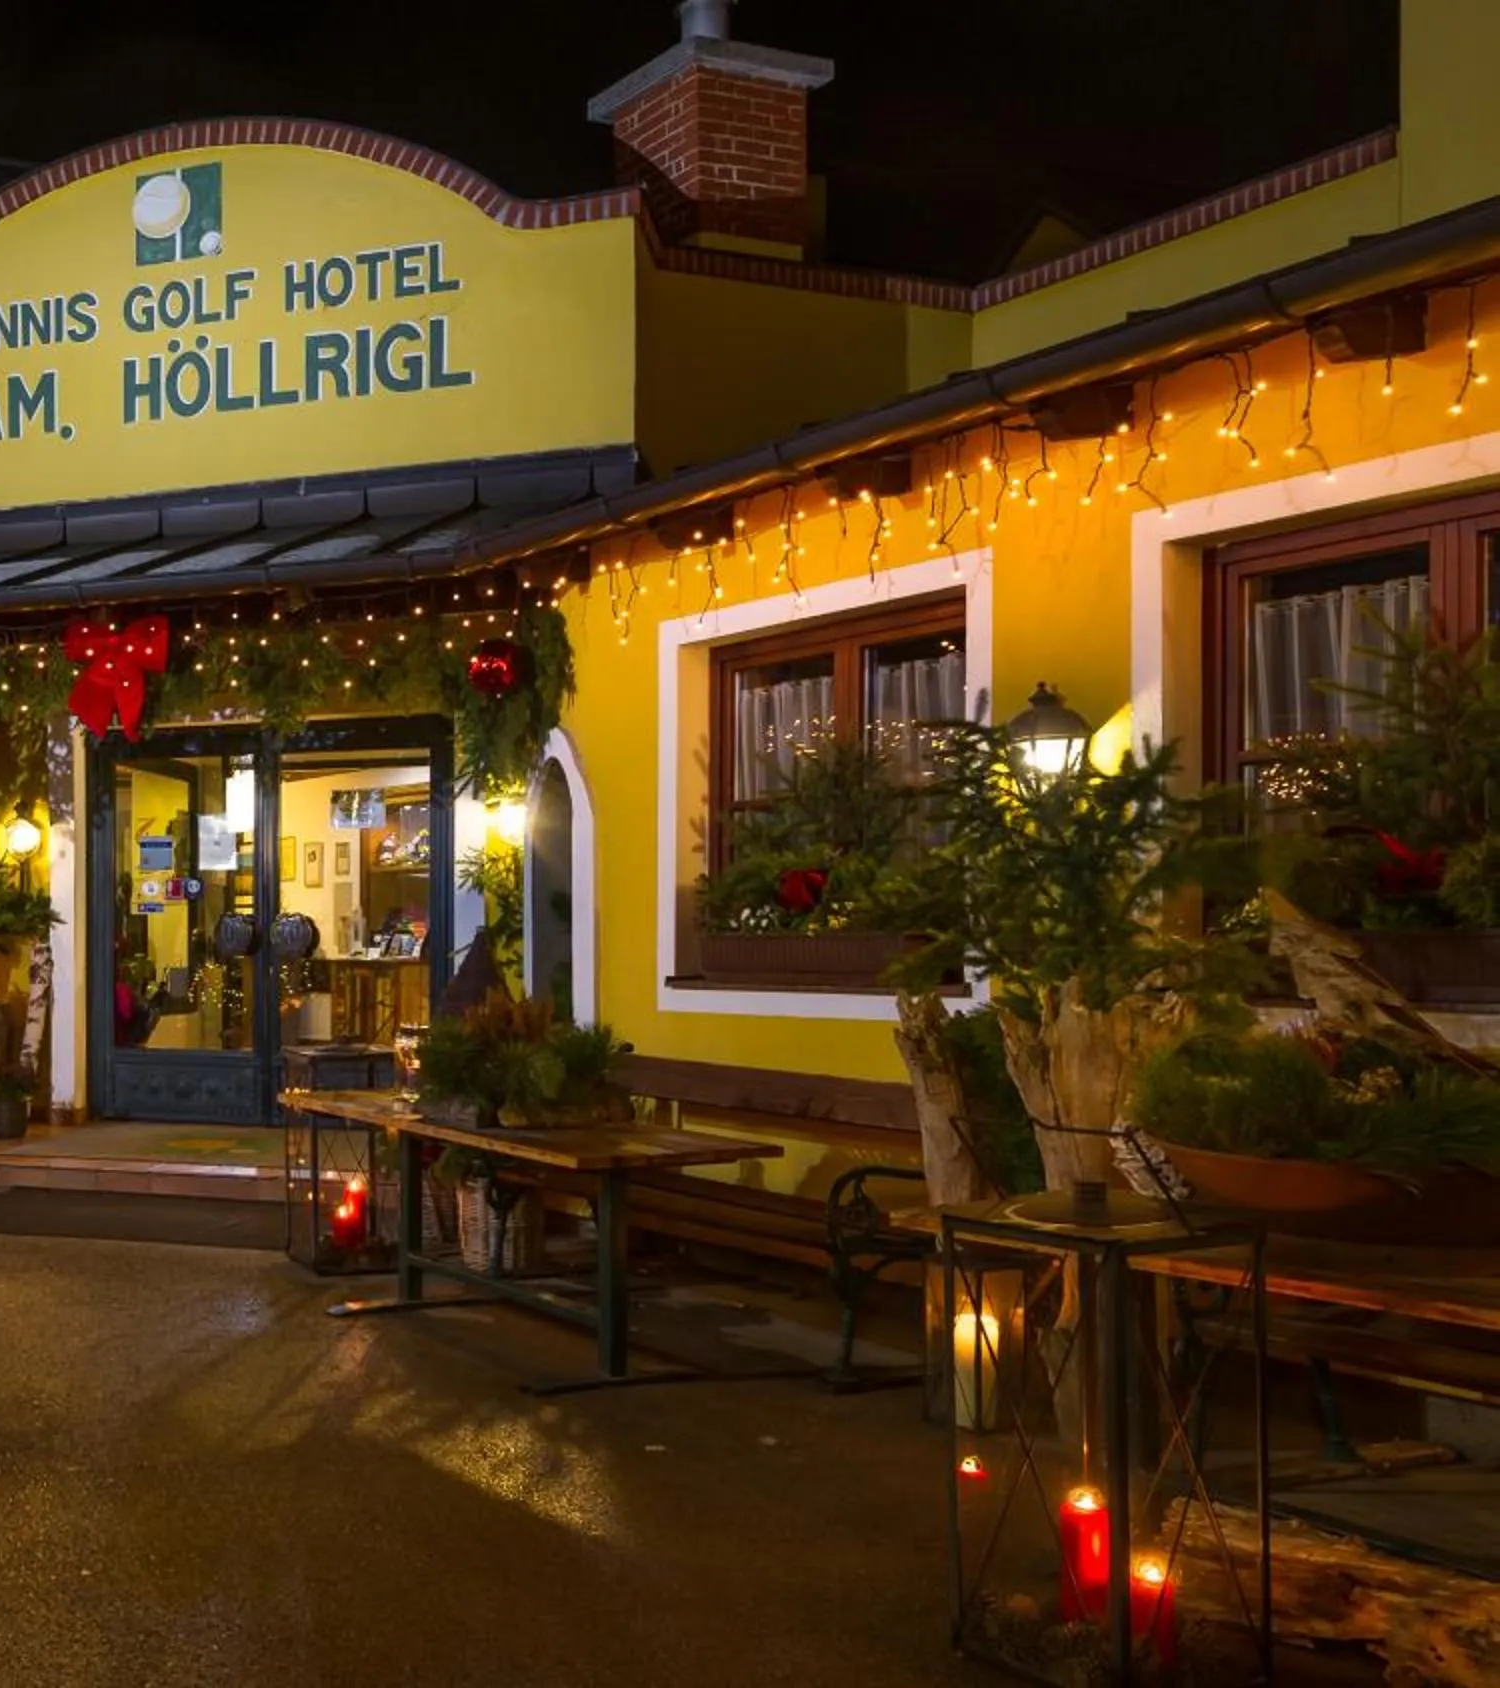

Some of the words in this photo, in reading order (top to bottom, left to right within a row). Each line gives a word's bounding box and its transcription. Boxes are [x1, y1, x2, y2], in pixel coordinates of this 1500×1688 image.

[124, 270, 254, 332] GOLF
[284, 243, 461, 311] HOTEL
[123, 318, 474, 424] HÖLLRIGL
